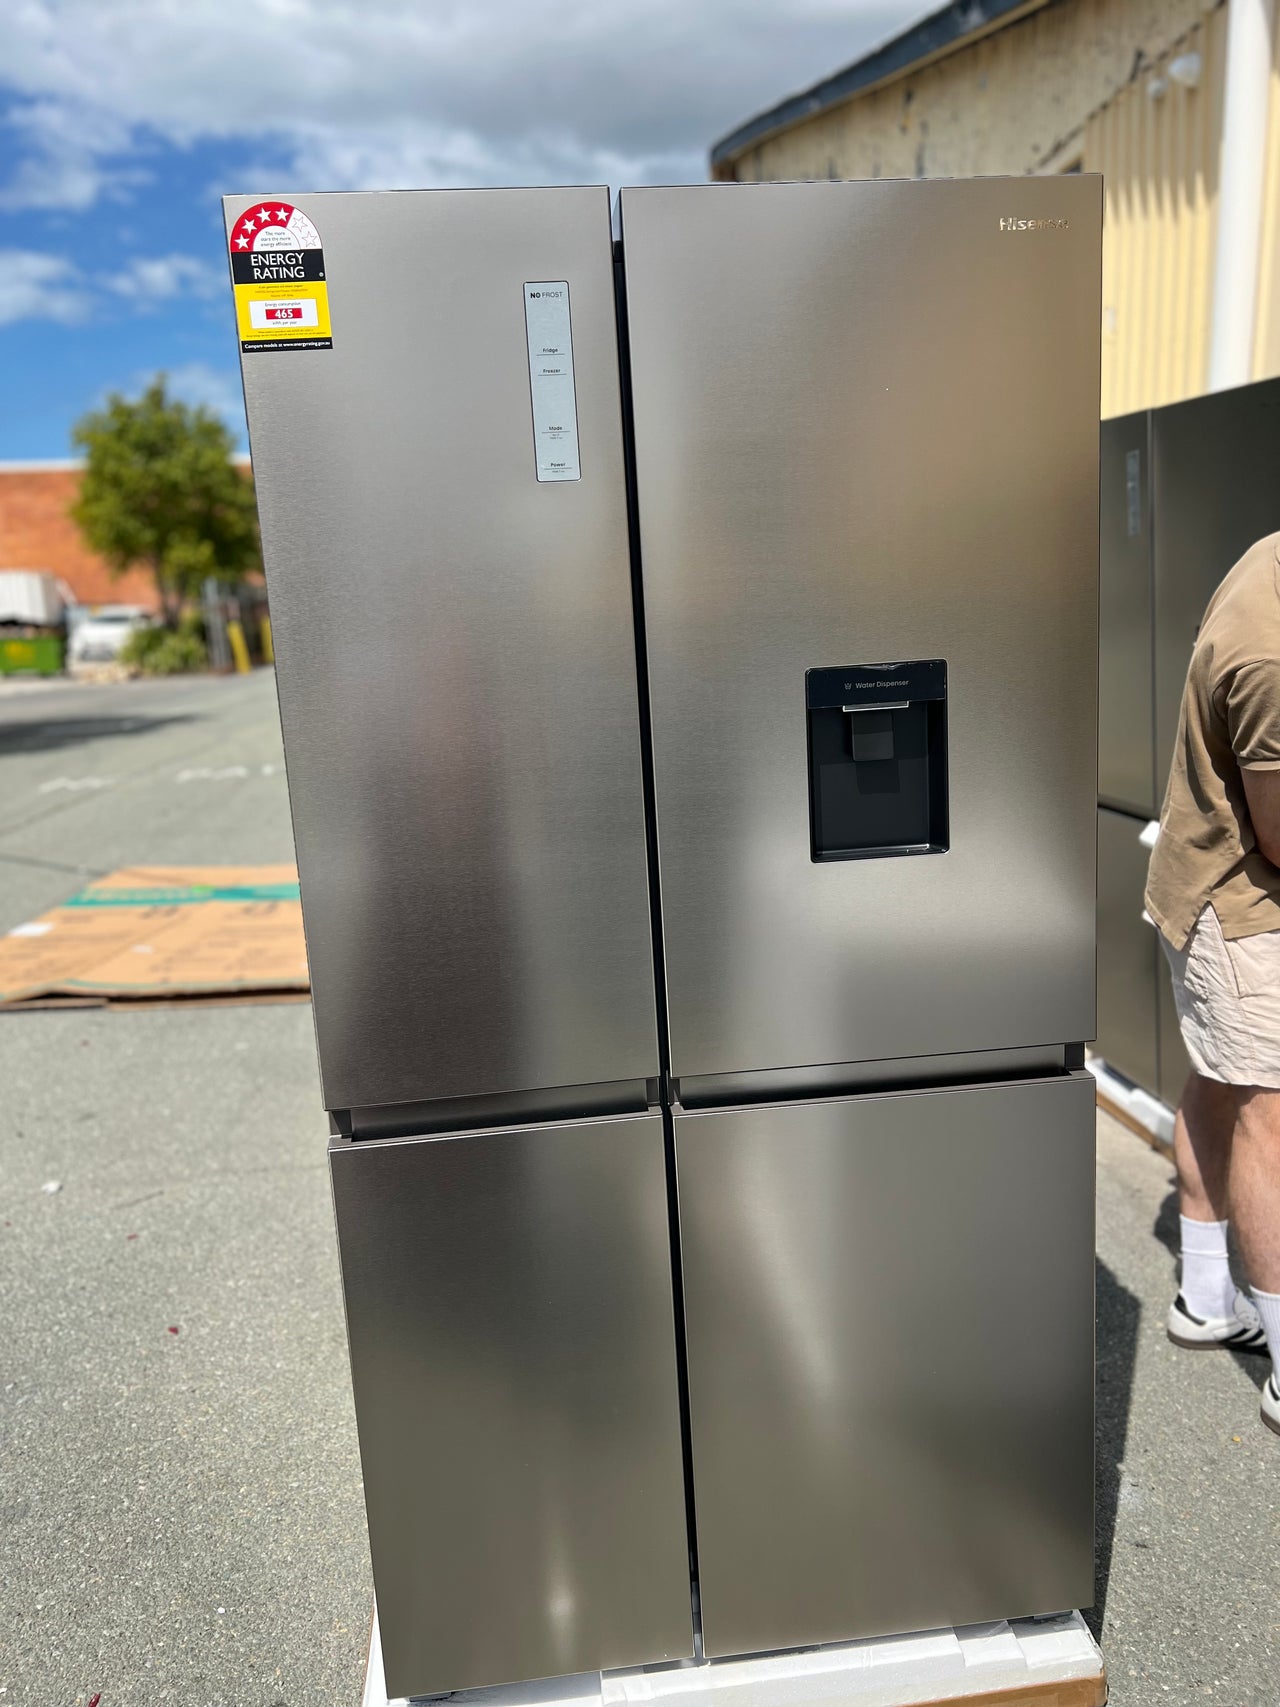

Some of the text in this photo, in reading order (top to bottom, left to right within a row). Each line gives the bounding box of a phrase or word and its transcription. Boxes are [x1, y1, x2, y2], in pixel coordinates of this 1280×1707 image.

[250, 252, 304, 266] ENERGY
[253, 266, 304, 280] RATING
[275, 309, 293, 319] 465
[876, 680, 909, 688] Dispenser
